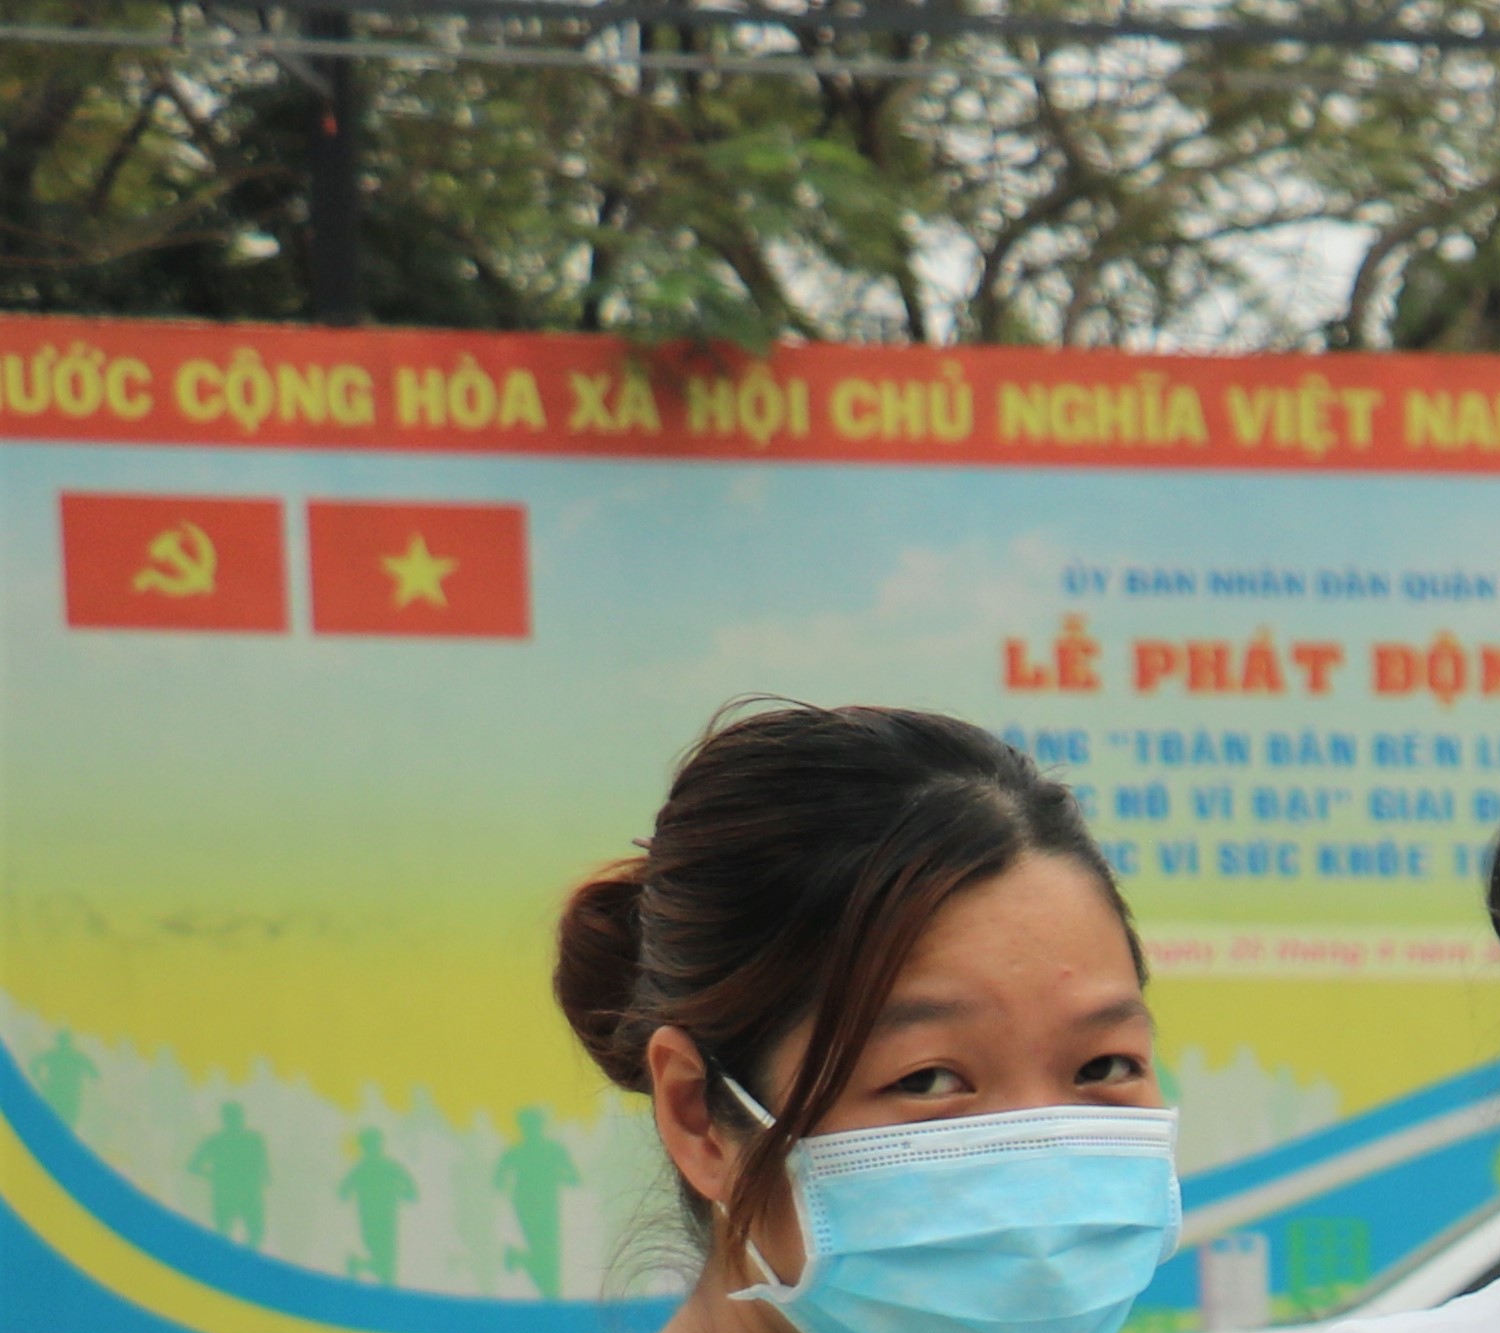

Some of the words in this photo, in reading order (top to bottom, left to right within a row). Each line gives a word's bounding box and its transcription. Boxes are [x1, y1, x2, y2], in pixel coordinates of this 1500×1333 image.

[0, 343, 152, 418] ƯỚC
[174, 347, 376, 433] CỘNG
[396, 353, 547, 431] HÒA
[687, 363, 809, 448] HỘI
[829, 358, 973, 439] CHỦ
[998, 369, 1208, 446] NGHĨA
[1226, 372, 1381, 460] VIỆT
[1003, 613, 1101, 692] LỄ
[1132, 625, 1344, 695] PHÁT
[1368, 787, 1457, 822] GIAI
